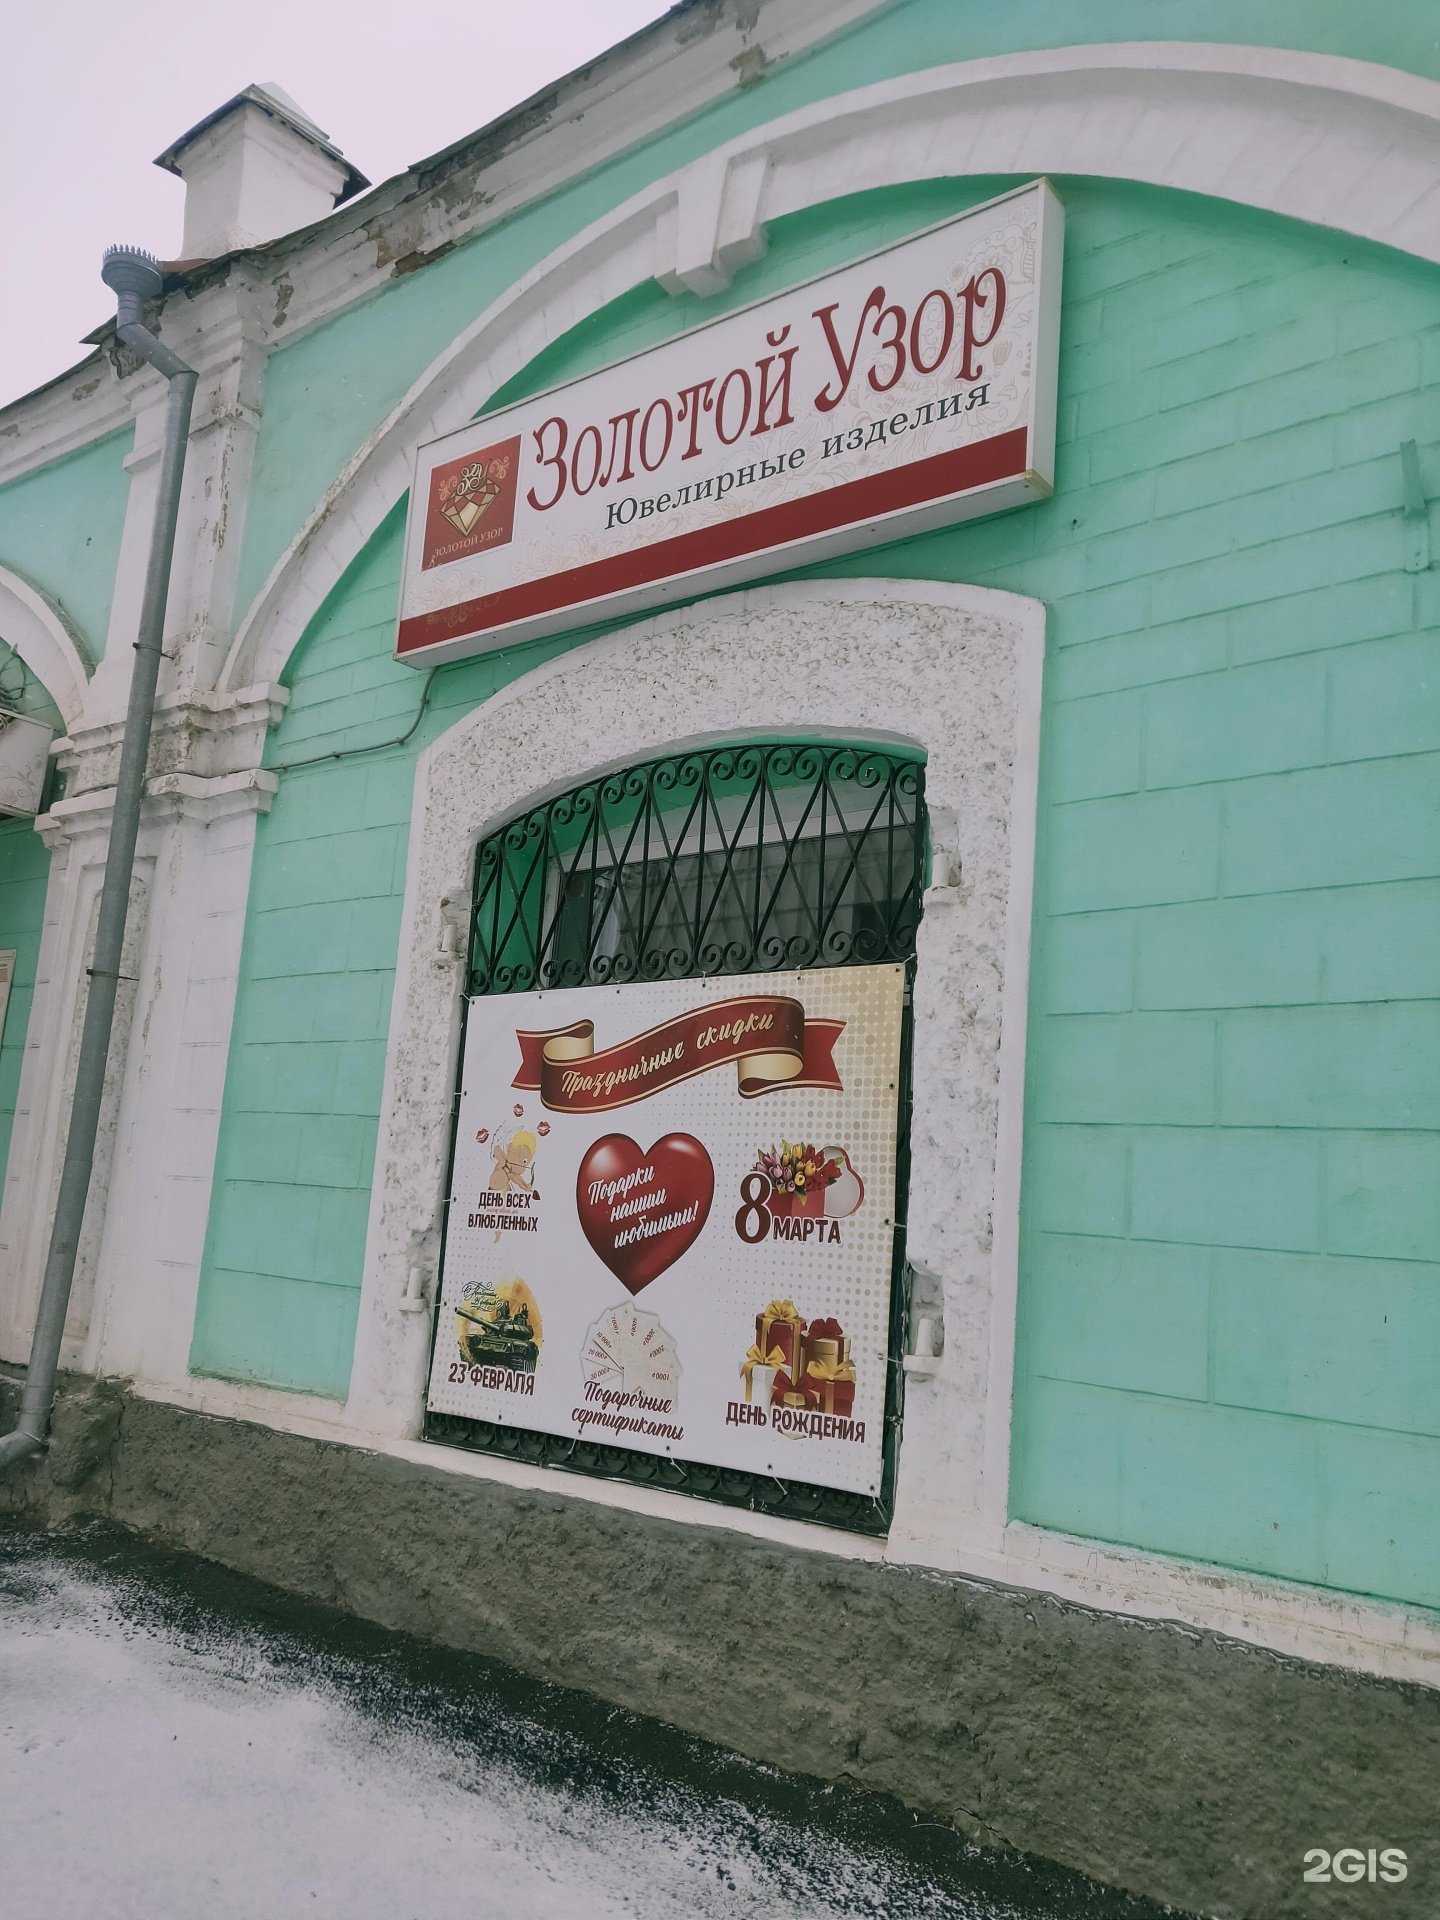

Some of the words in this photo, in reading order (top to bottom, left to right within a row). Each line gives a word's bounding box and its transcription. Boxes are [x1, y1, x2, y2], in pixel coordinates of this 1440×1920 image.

[812, 267, 1007, 413] Узор
[604, 448, 806, 531] Ювелирные
[821, 382, 992, 460] изделия
[561, 1040, 686, 1099] Праздничные
[696, 1012, 774, 1051] скидки
[479, 1192, 504, 1209] ДЕНЬ
[506, 1193, 531, 1208] ВСЕХ
[588, 1165, 656, 1206] Подарки
[610, 1189, 667, 1223] нашим
[468, 1213, 539, 1232] ВЛЮБЛЕННЫХ
[614, 1201, 700, 1249] любимым!
[735, 1172, 772, 1244] 8
[772, 1217, 842, 1245] МАРТА
[448, 1362, 469, 1385] 23
[470, 1364, 536, 1396] ФЕВРАЛЯ
[583, 1380, 672, 1413] Подарочные
[571, 1407, 683, 1441] сертификаты
[726, 1402, 768, 1427] ДЕНЬ
[772, 1407, 867, 1444] РОЖДЕНИЯ
